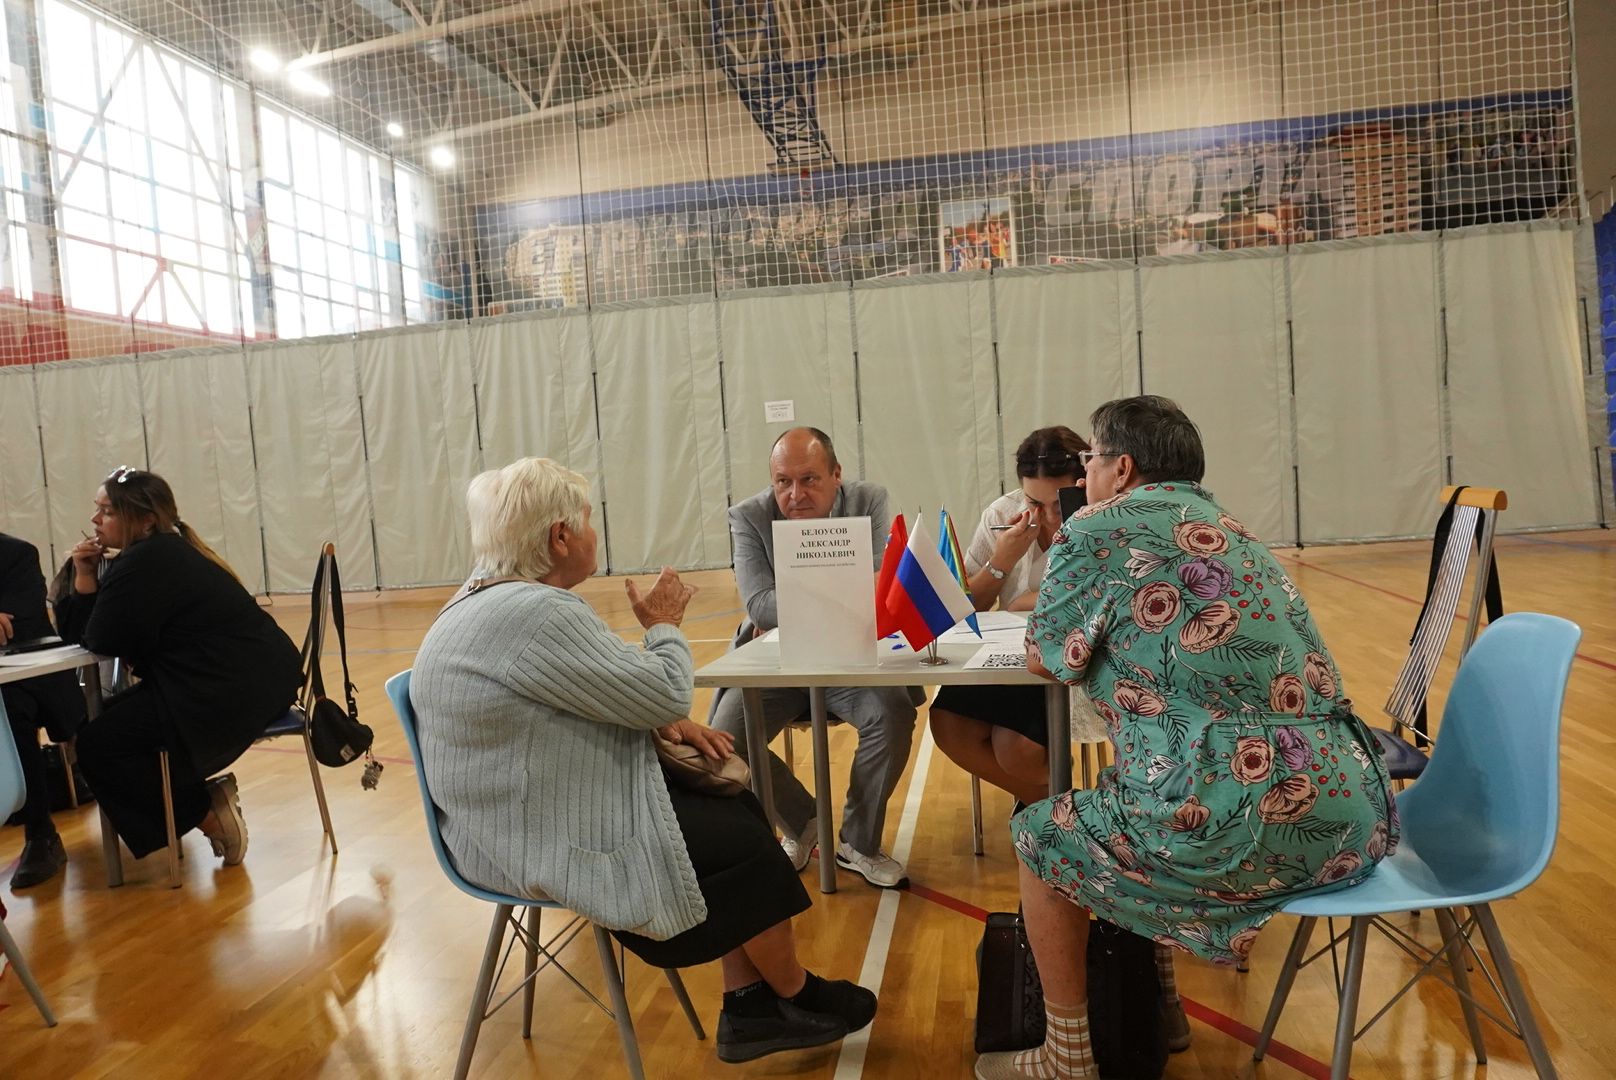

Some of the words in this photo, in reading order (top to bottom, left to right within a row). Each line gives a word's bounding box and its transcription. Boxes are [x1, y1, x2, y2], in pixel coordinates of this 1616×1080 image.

[1042, 147, 1345, 226] СПОРТА
[801, 527, 848, 536] БЕЛОУСОВ
[799, 539, 851, 548] АЛЕКСАНДР
[796, 550, 855, 559] НИКОЛАЕВИЧ
